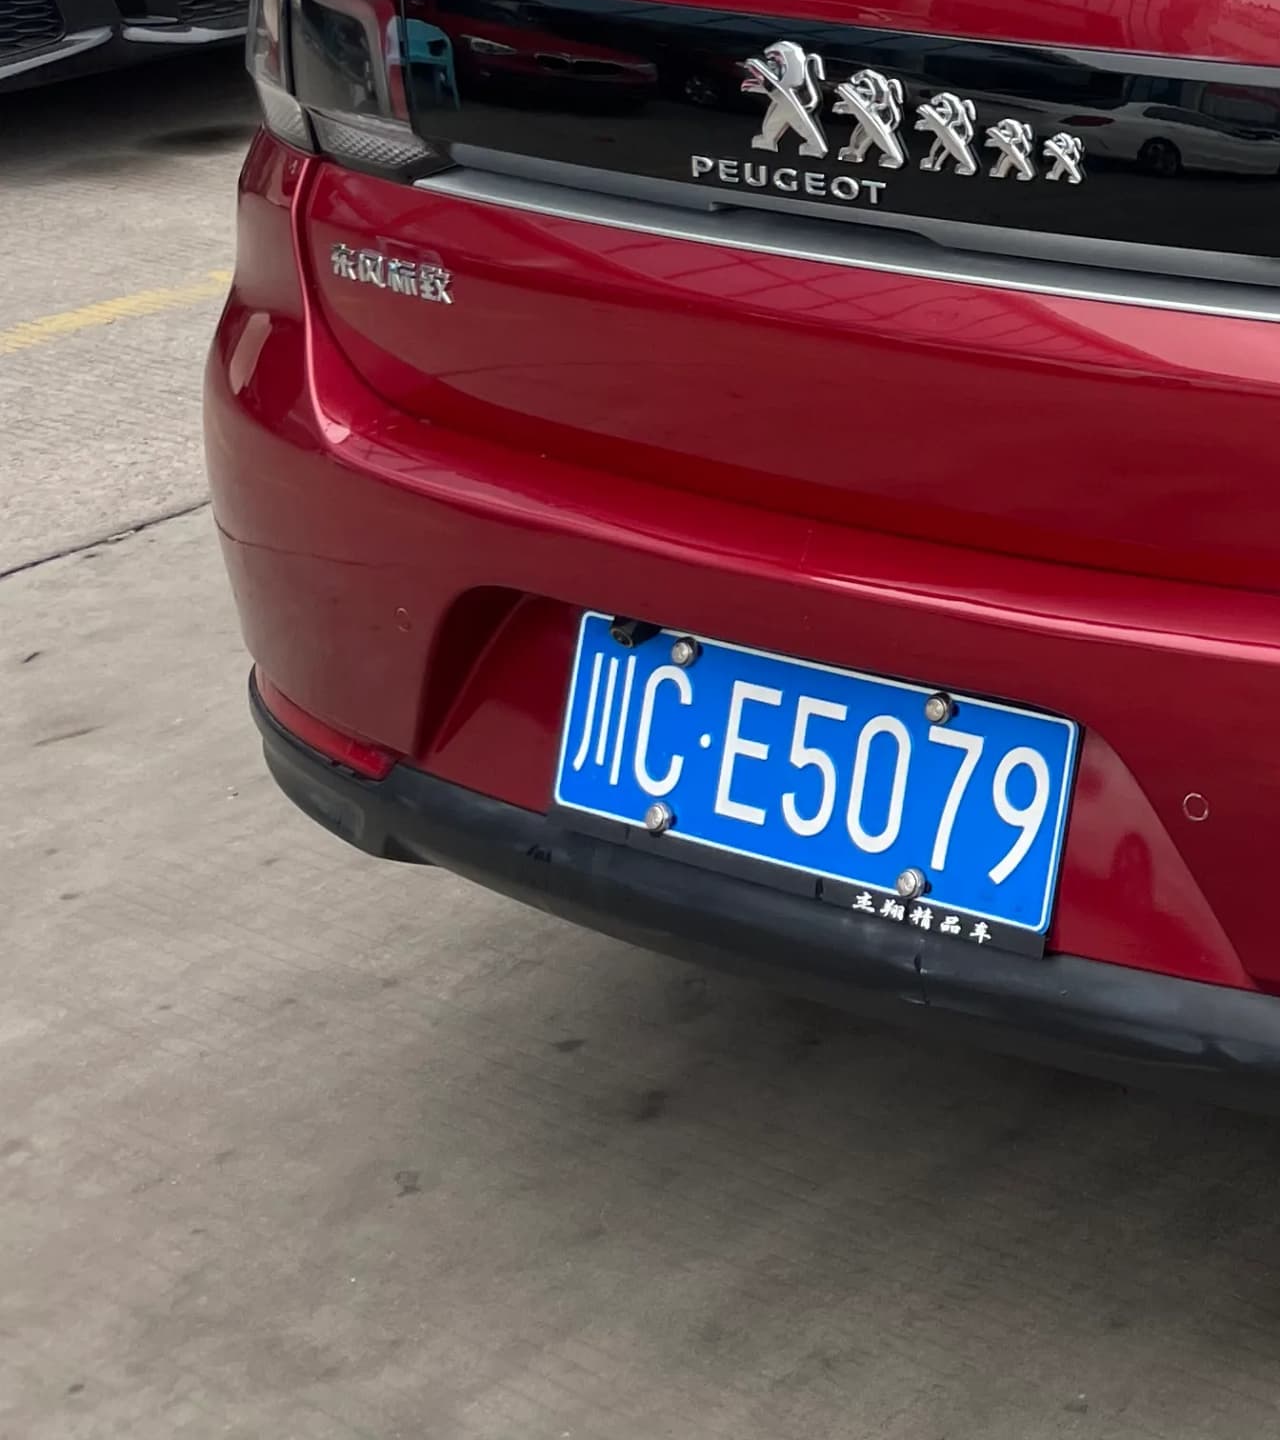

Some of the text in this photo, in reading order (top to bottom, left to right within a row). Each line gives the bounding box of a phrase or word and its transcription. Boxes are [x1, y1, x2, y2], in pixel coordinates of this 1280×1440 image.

[691, 155, 887, 205] PEUGEOT
[331, 242, 452, 304] 东风标致
[573, 651, 1051, 886] 川C·E5079
